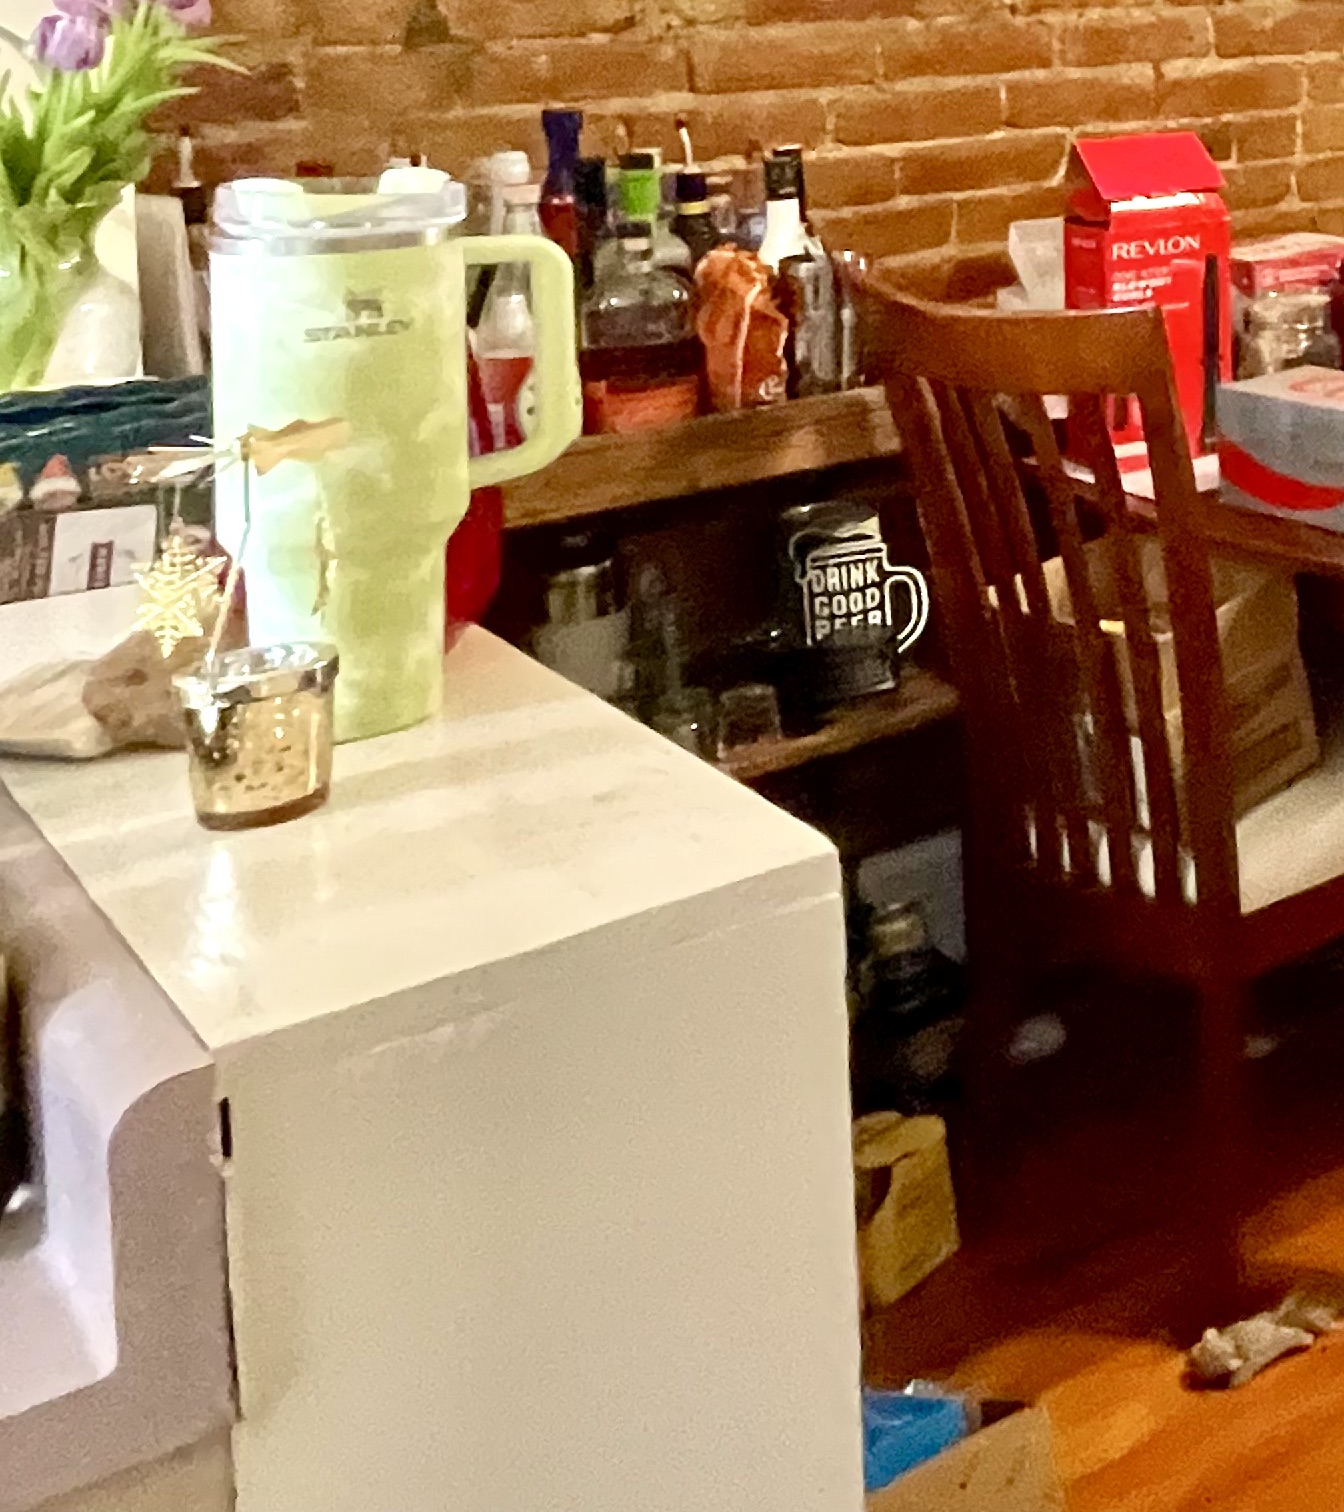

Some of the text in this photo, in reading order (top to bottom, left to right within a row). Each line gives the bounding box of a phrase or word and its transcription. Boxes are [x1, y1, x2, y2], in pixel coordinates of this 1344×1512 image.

[1111, 235, 1200, 260] REVLON
[303, 317, 415, 343] STANLEY
[811, 559, 880, 593] DRINK
[814, 587, 880, 617] GOOD
